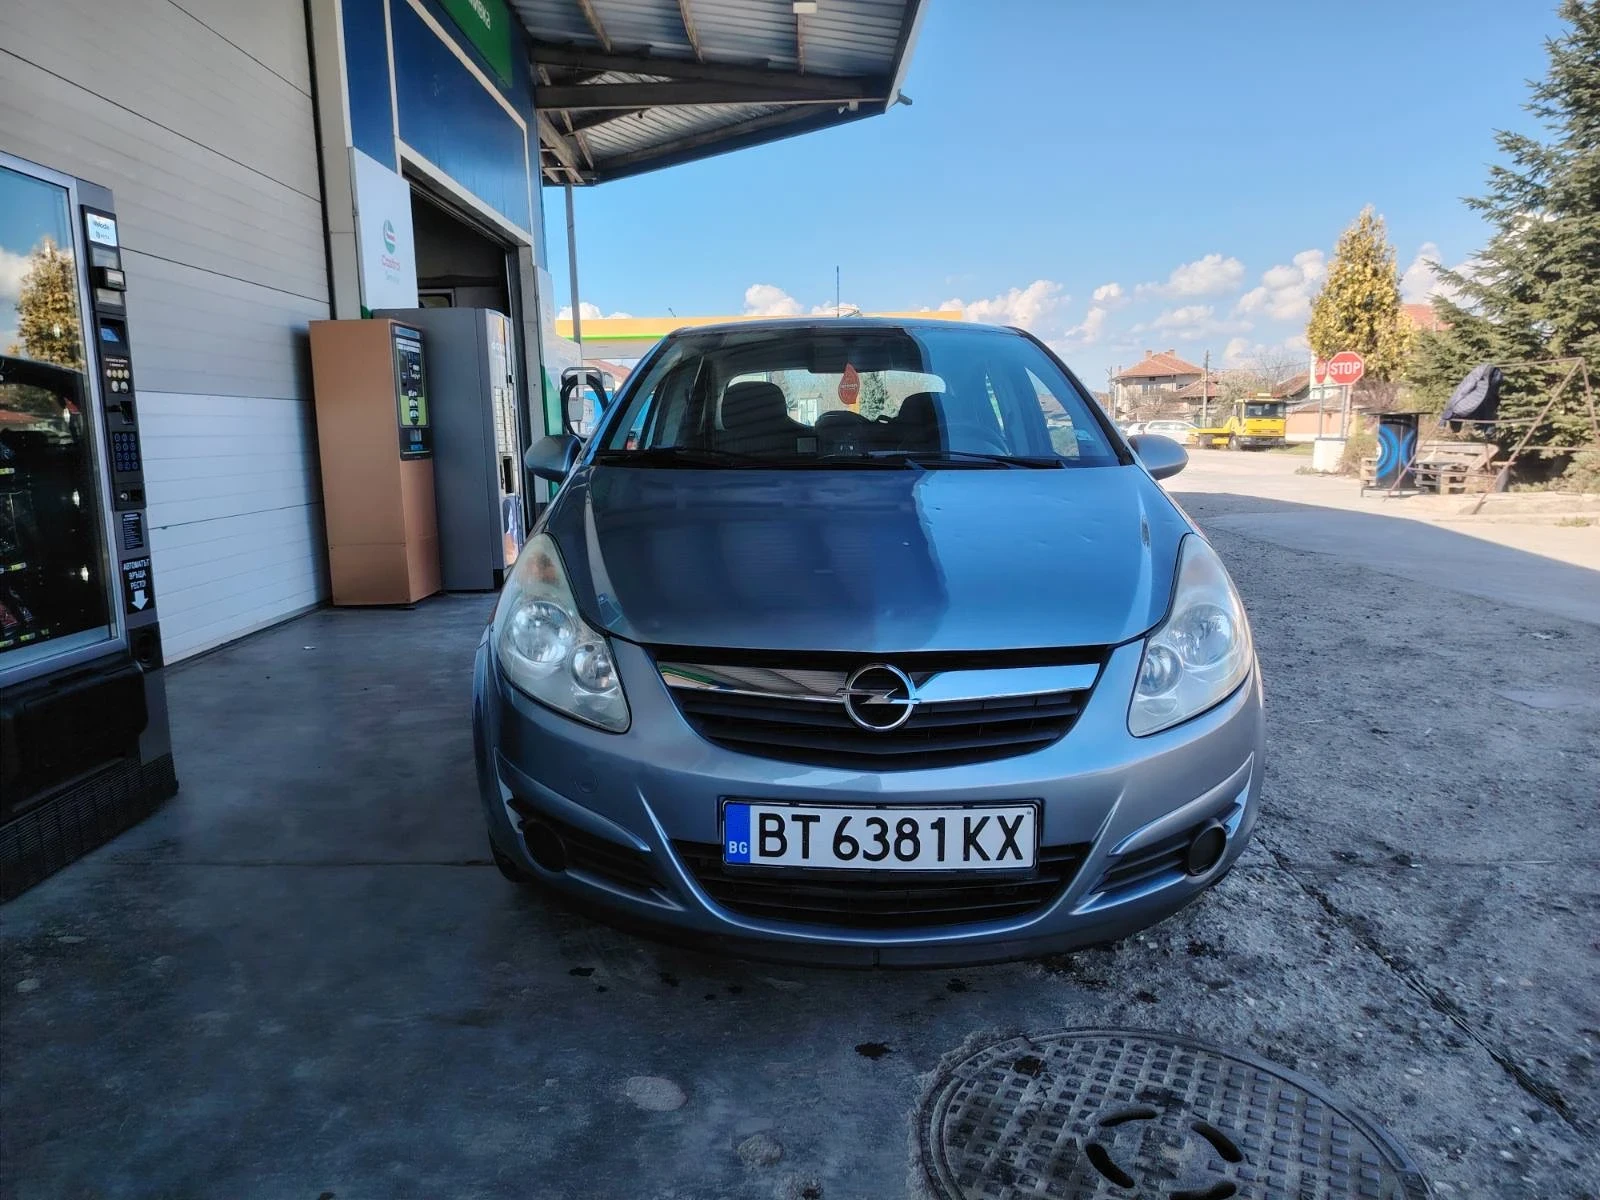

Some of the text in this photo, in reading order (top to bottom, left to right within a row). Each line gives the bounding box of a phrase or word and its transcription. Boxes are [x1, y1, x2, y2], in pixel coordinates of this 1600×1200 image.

[1330, 361, 1361, 376] STOP
[728, 812, 1025, 862] BG BT 6381 KX
